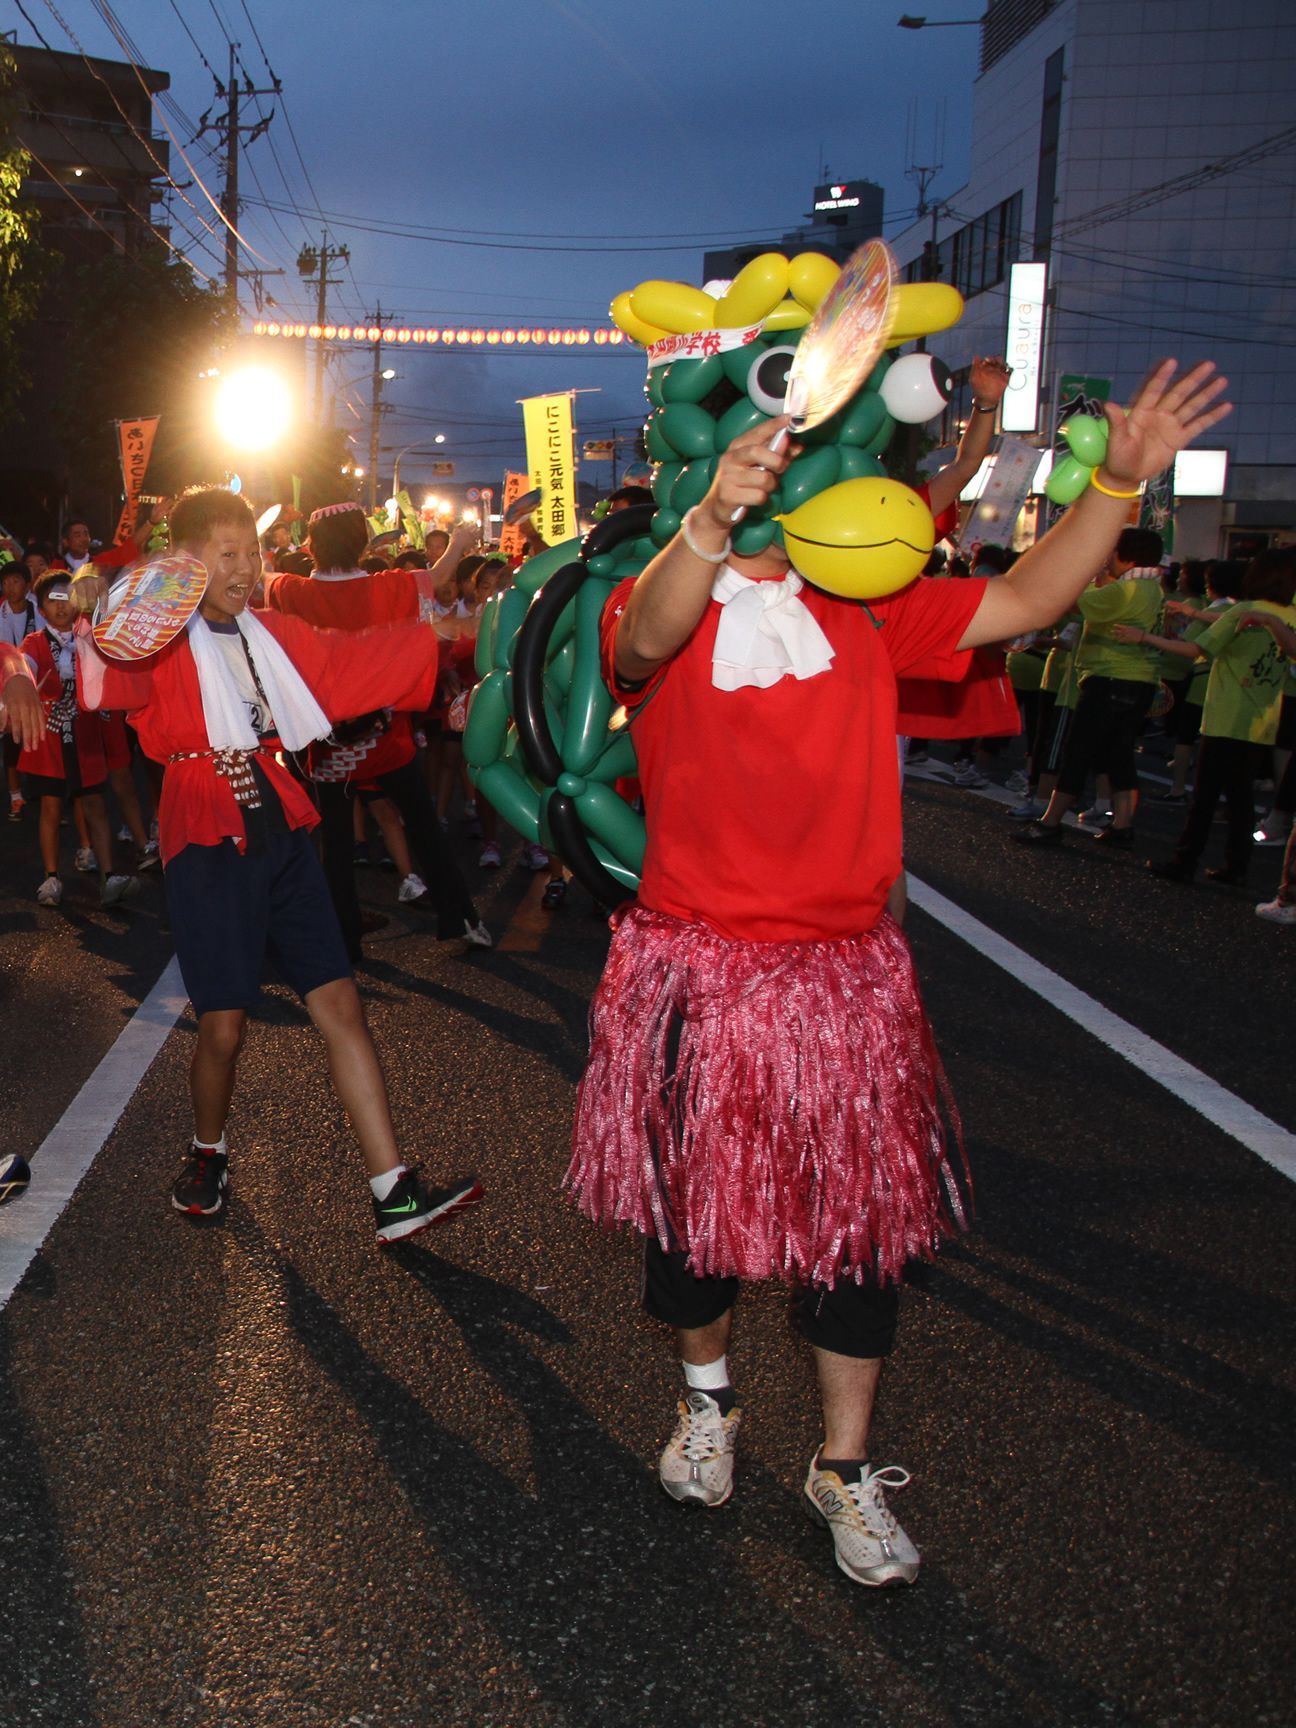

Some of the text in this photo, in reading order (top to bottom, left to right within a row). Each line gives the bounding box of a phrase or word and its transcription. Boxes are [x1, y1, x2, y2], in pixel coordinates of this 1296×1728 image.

[547, 406, 566, 537] にこにこ元気 太田郷
